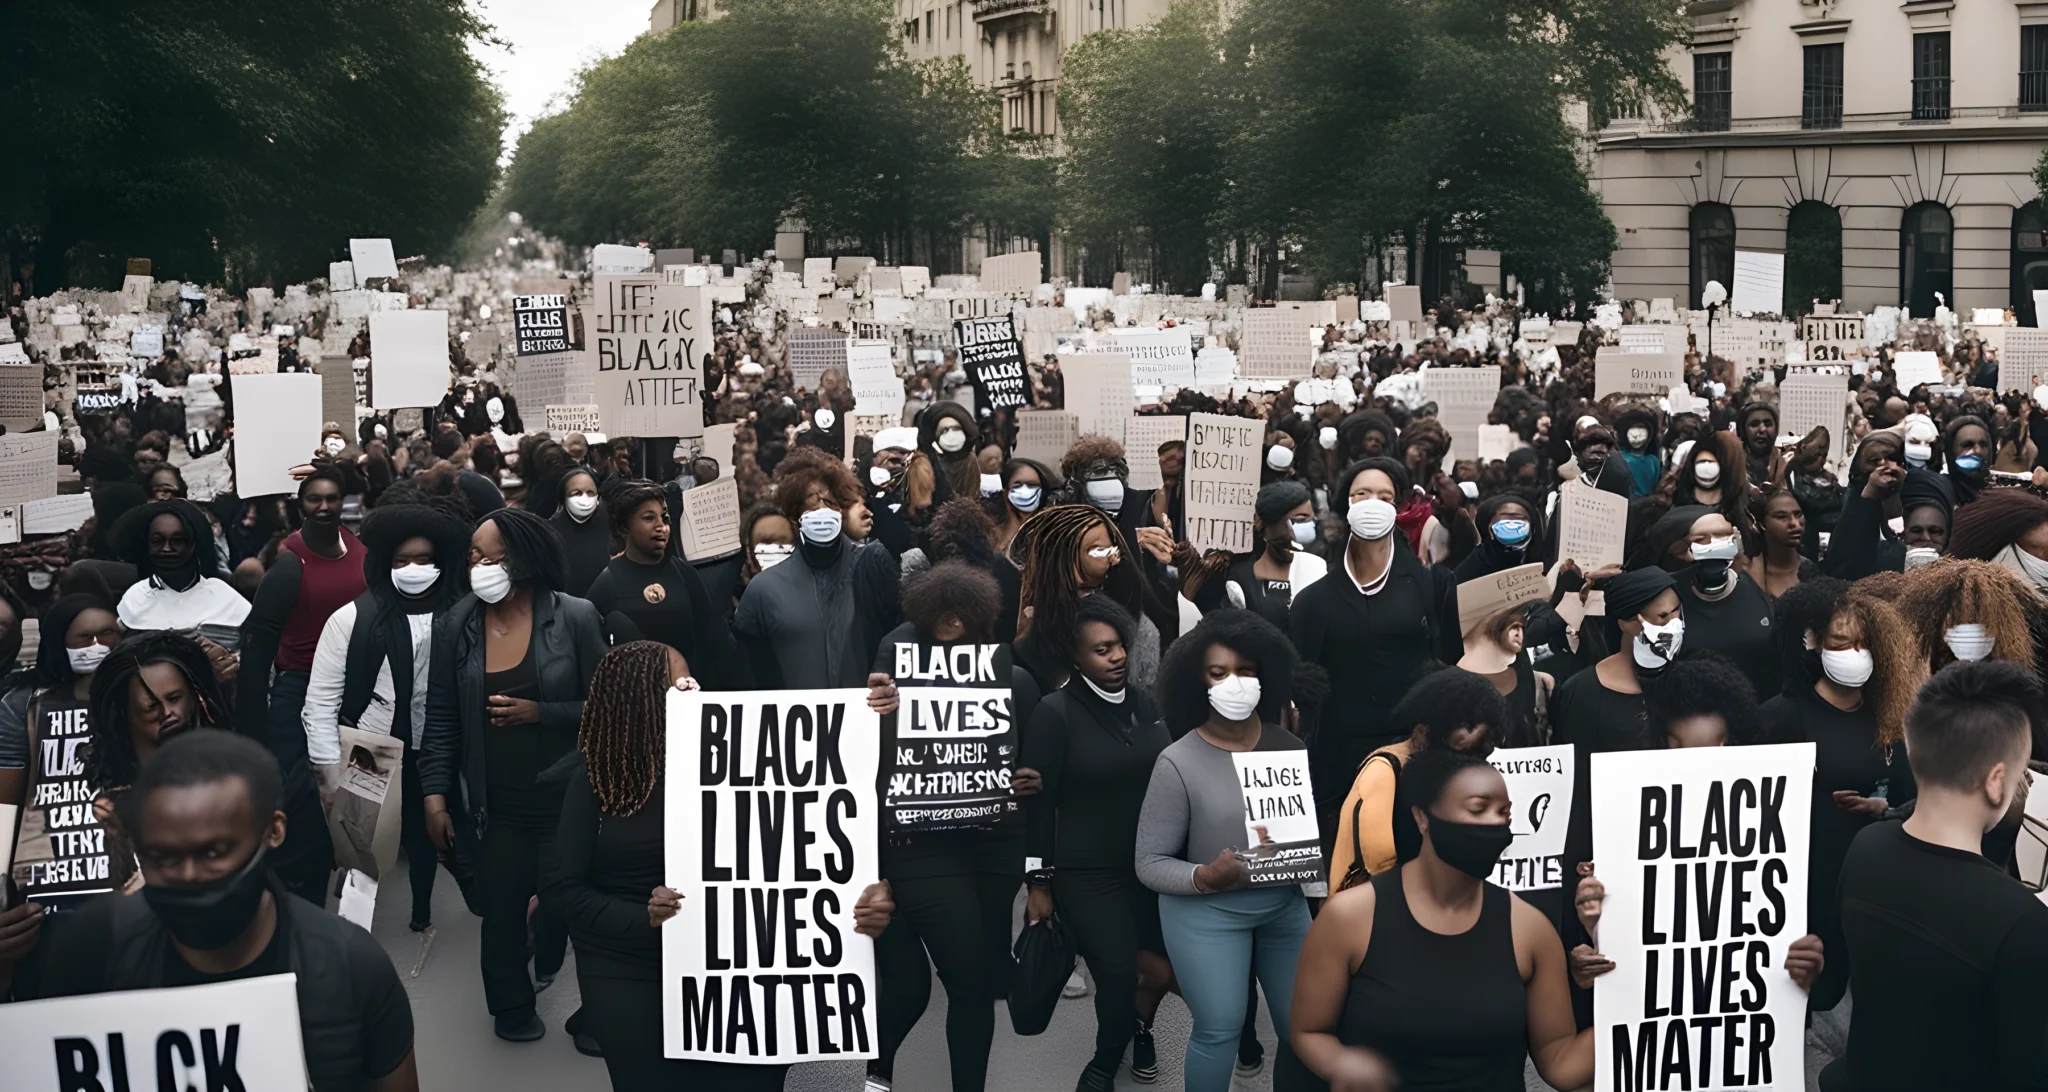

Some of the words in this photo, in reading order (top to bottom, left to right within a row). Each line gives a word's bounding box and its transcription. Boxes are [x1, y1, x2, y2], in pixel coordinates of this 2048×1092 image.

[700, 703, 847, 787] BLACK
[702, 788, 857, 884] LIVES
[1637, 775, 1787, 860] BLACK
[705, 886, 842, 970] LIVES
[1642, 858, 1788, 945] LIVES
[682, 972, 869, 1056] MATTER
[1644, 941, 1770, 1019] LIVES
[1612, 1012, 1775, 1092] MATER
